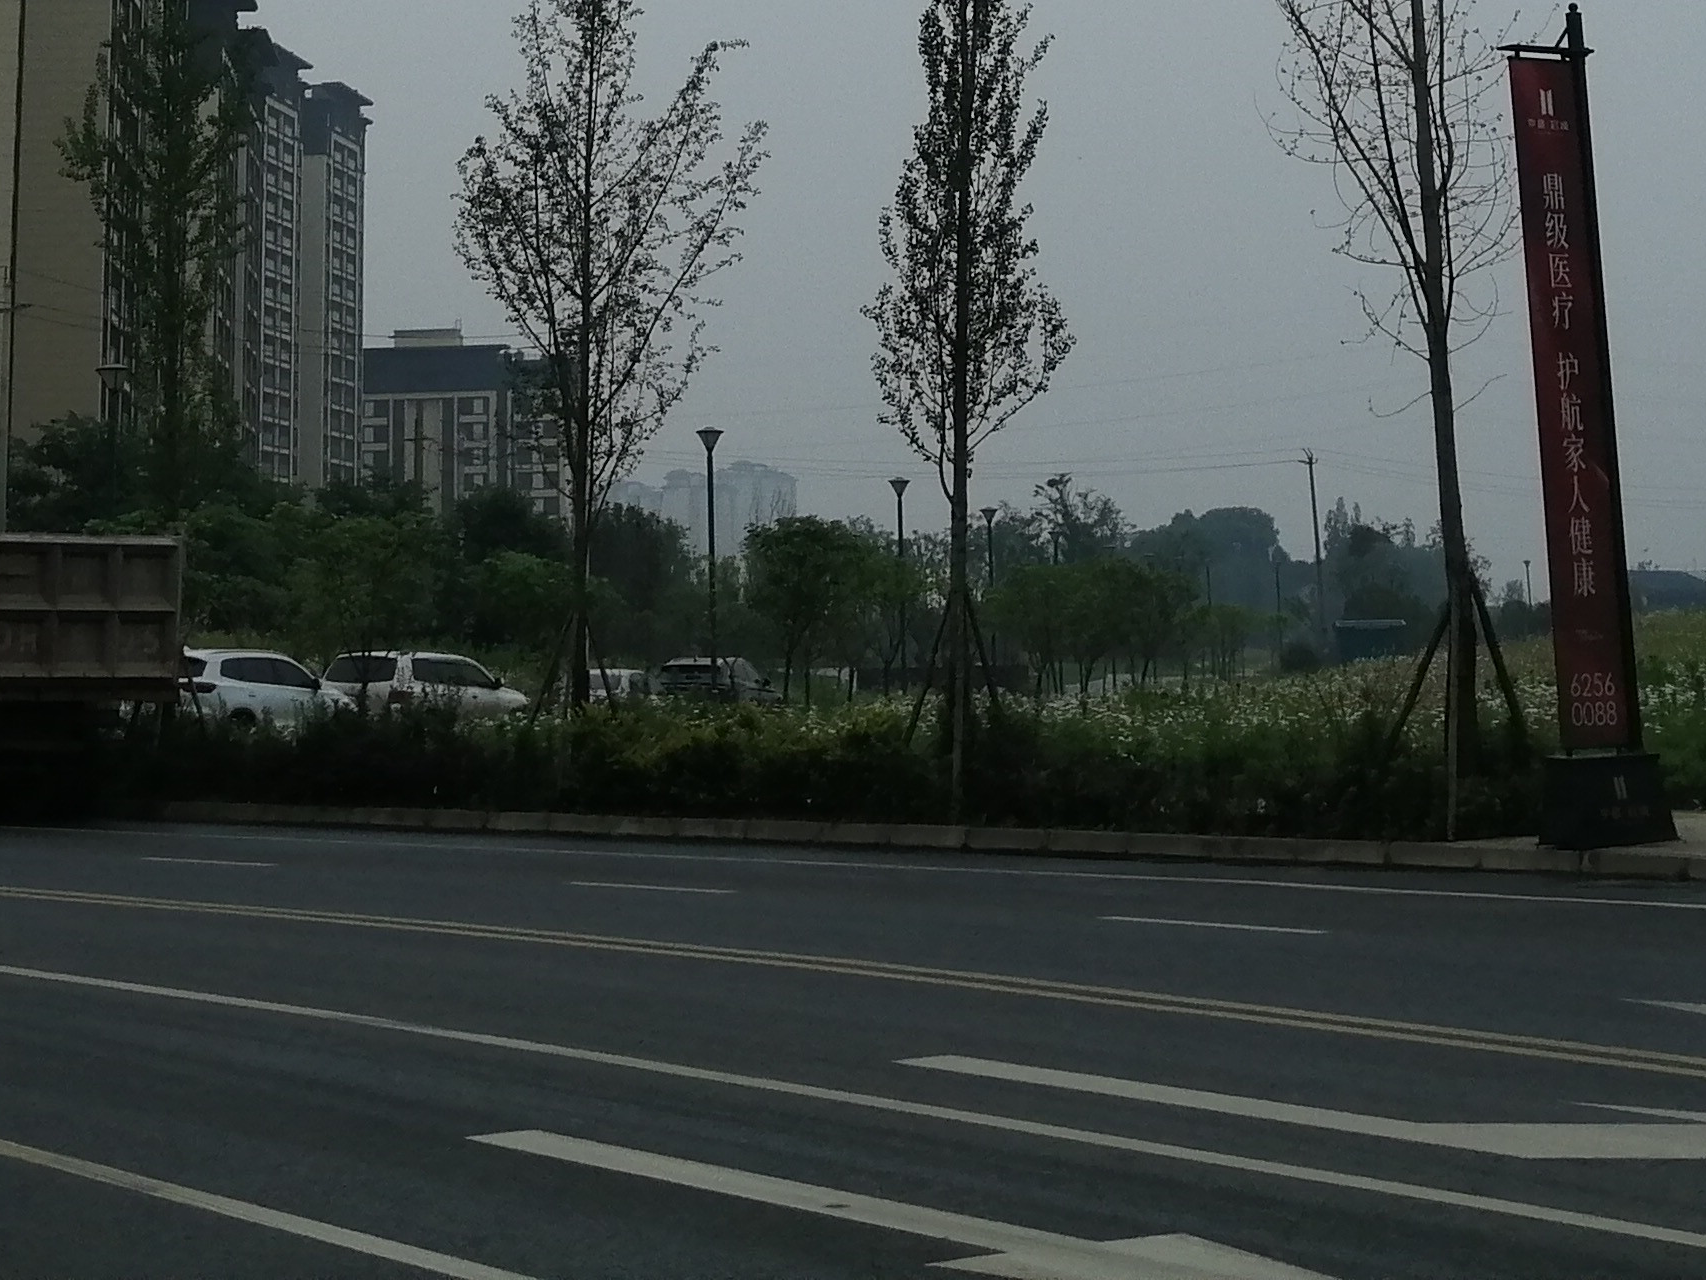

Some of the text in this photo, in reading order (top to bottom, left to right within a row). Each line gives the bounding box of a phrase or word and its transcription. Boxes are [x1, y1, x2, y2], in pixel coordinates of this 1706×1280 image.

[1541, 171, 1575, 331] 鼎级医疗
[1556, 351, 1596, 598] 护航家人健康
[1569, 701, 1618, 728] 0088
[1570, 672, 1616, 698] 6256
